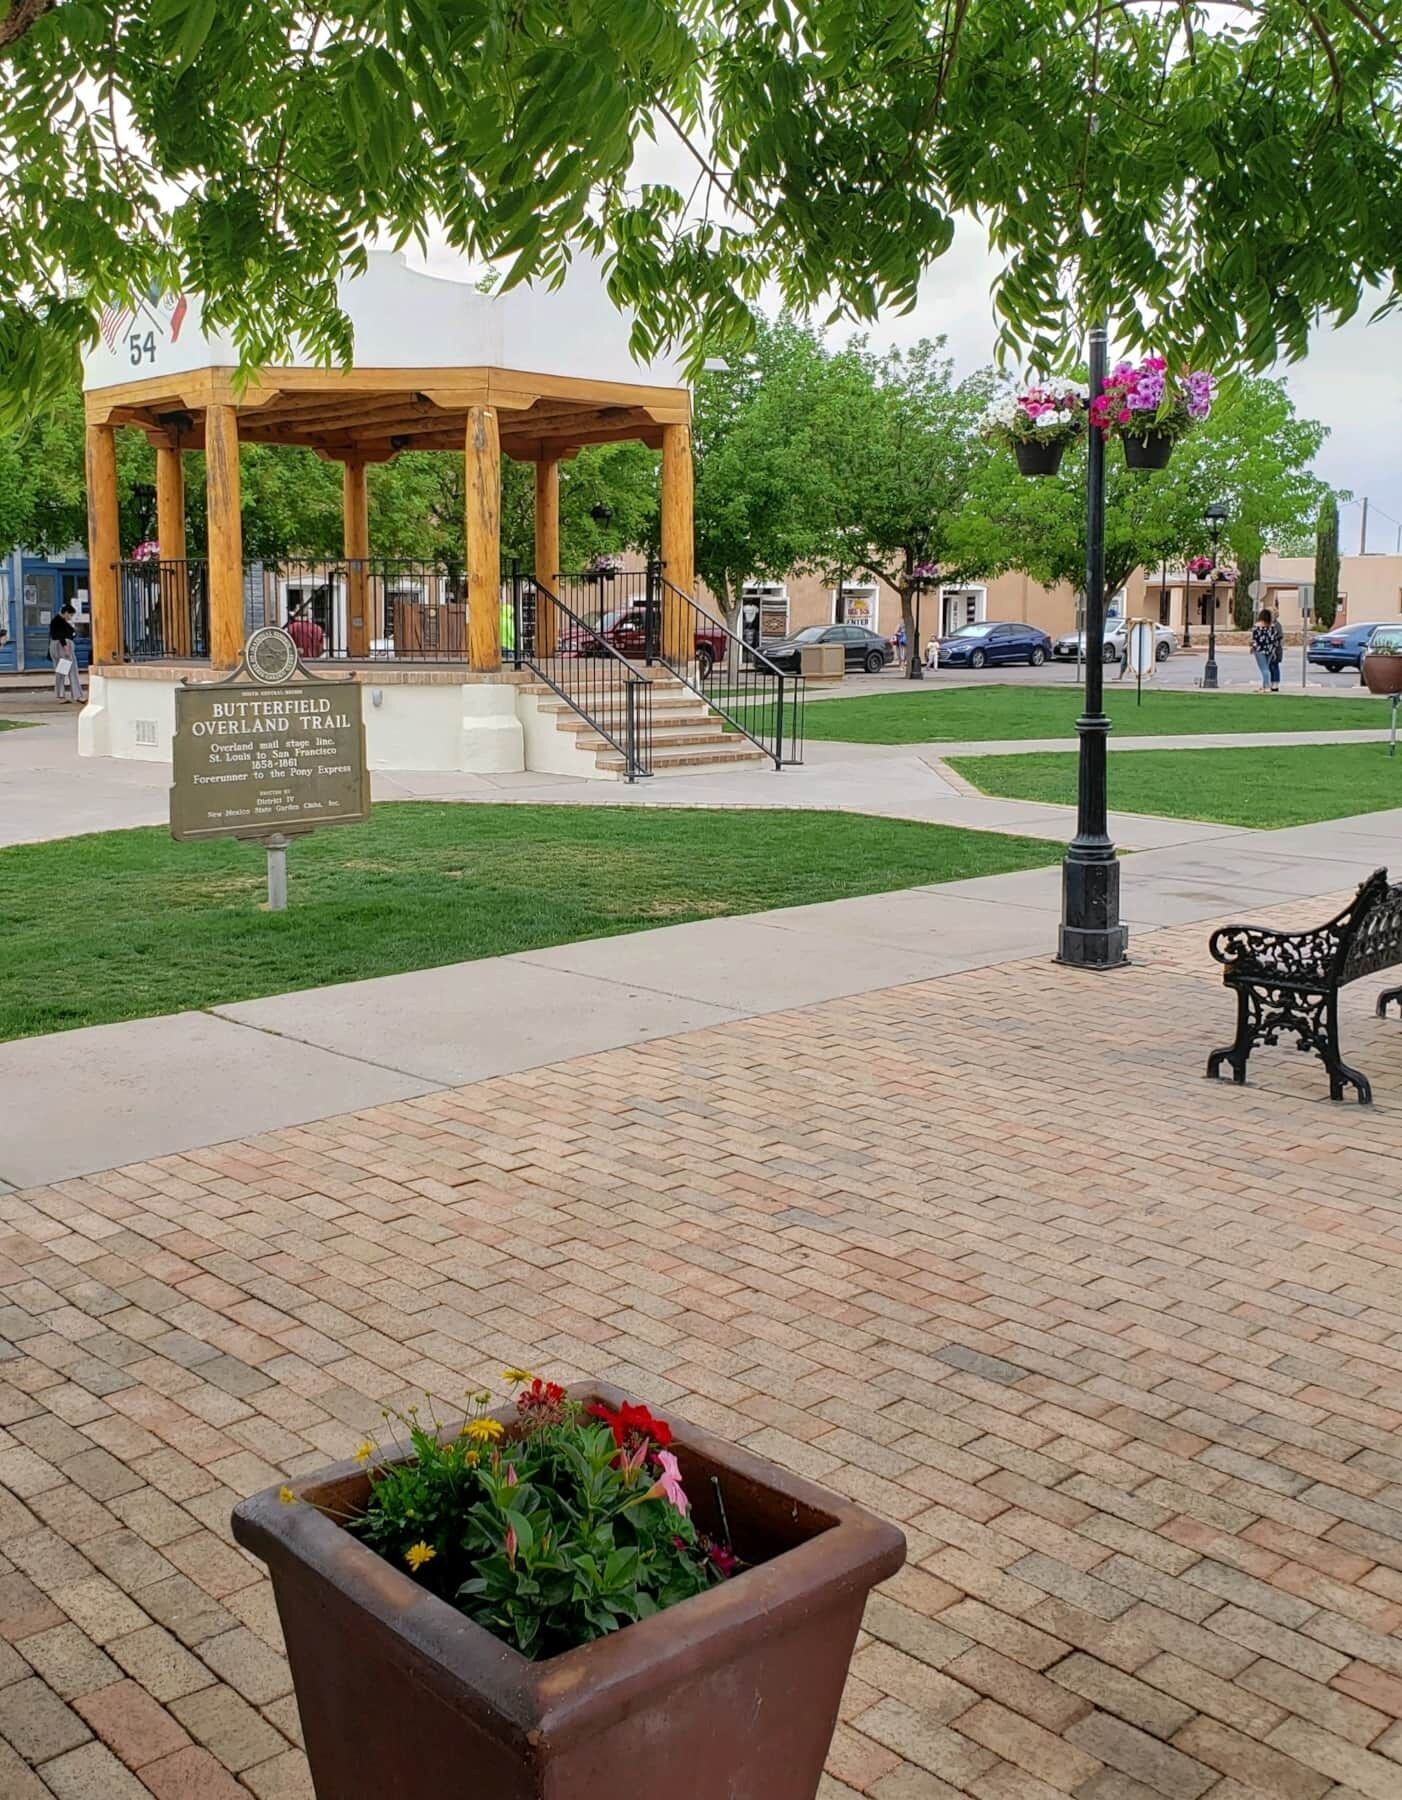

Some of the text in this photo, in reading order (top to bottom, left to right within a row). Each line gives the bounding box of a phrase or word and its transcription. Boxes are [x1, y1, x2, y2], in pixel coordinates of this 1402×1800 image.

[129, 331, 156, 366] 54
[212, 698, 331, 718] BUTTERFIELD
[191, 714, 351, 737] OVERLAND TRAIL
[208, 747, 337, 763] St. Louis to San Francisco
[210, 741, 254, 753] Overland
[259, 740, 279, 750] mail
[285, 739, 310, 749] stage
[193, 764, 352, 785] Forerunner to the Pony Express
[225, 808, 251, 817] Mexico
